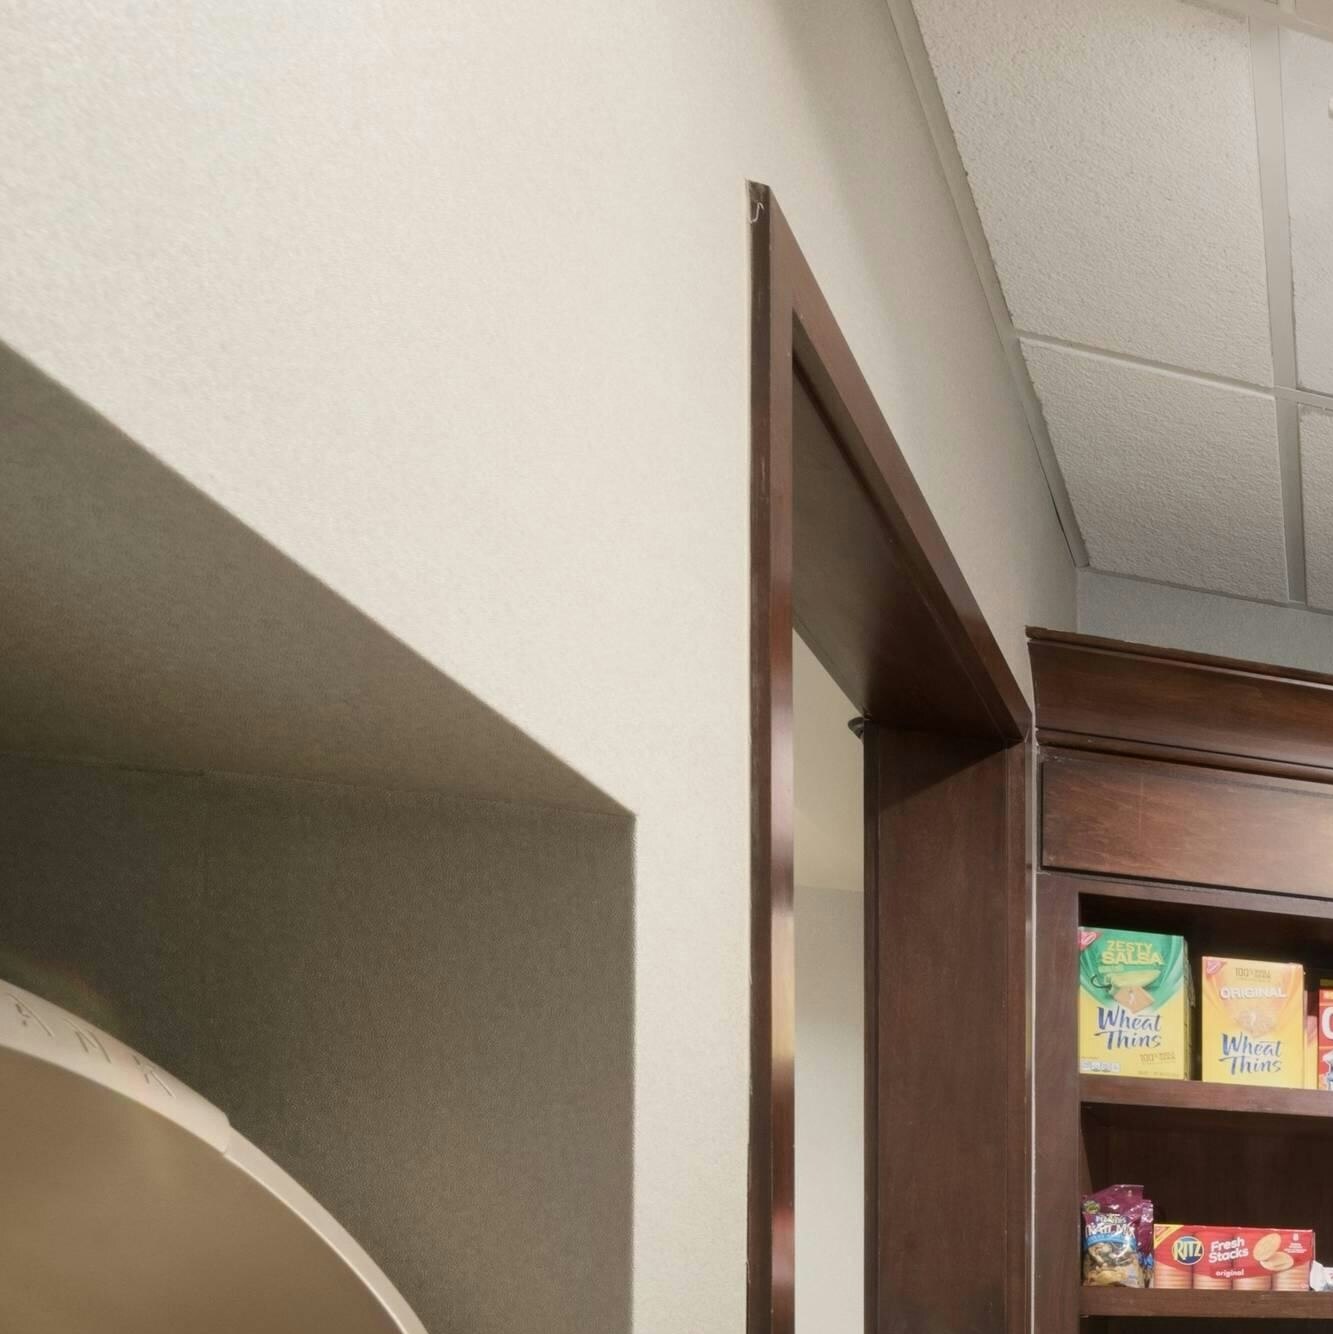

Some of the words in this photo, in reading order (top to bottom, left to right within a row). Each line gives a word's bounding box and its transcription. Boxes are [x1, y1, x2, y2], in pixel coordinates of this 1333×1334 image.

[1107, 940, 1152, 952] ZESTY
[1102, 951, 1164, 966] SALSA
[1220, 986, 1287, 999] ORIGINAL
[1097, 1006, 1162, 1031] Wheat
[1093, 1030, 1162, 1050] Thins
[1222, 1032, 1282, 1058] Wheat
[1173, 1236, 1203, 1262] RITZ
[1211, 1237, 1245, 1252] Fresh
[1208, 1248, 1249, 1264] Stacks
[1215, 1269, 1245, 1278] original
